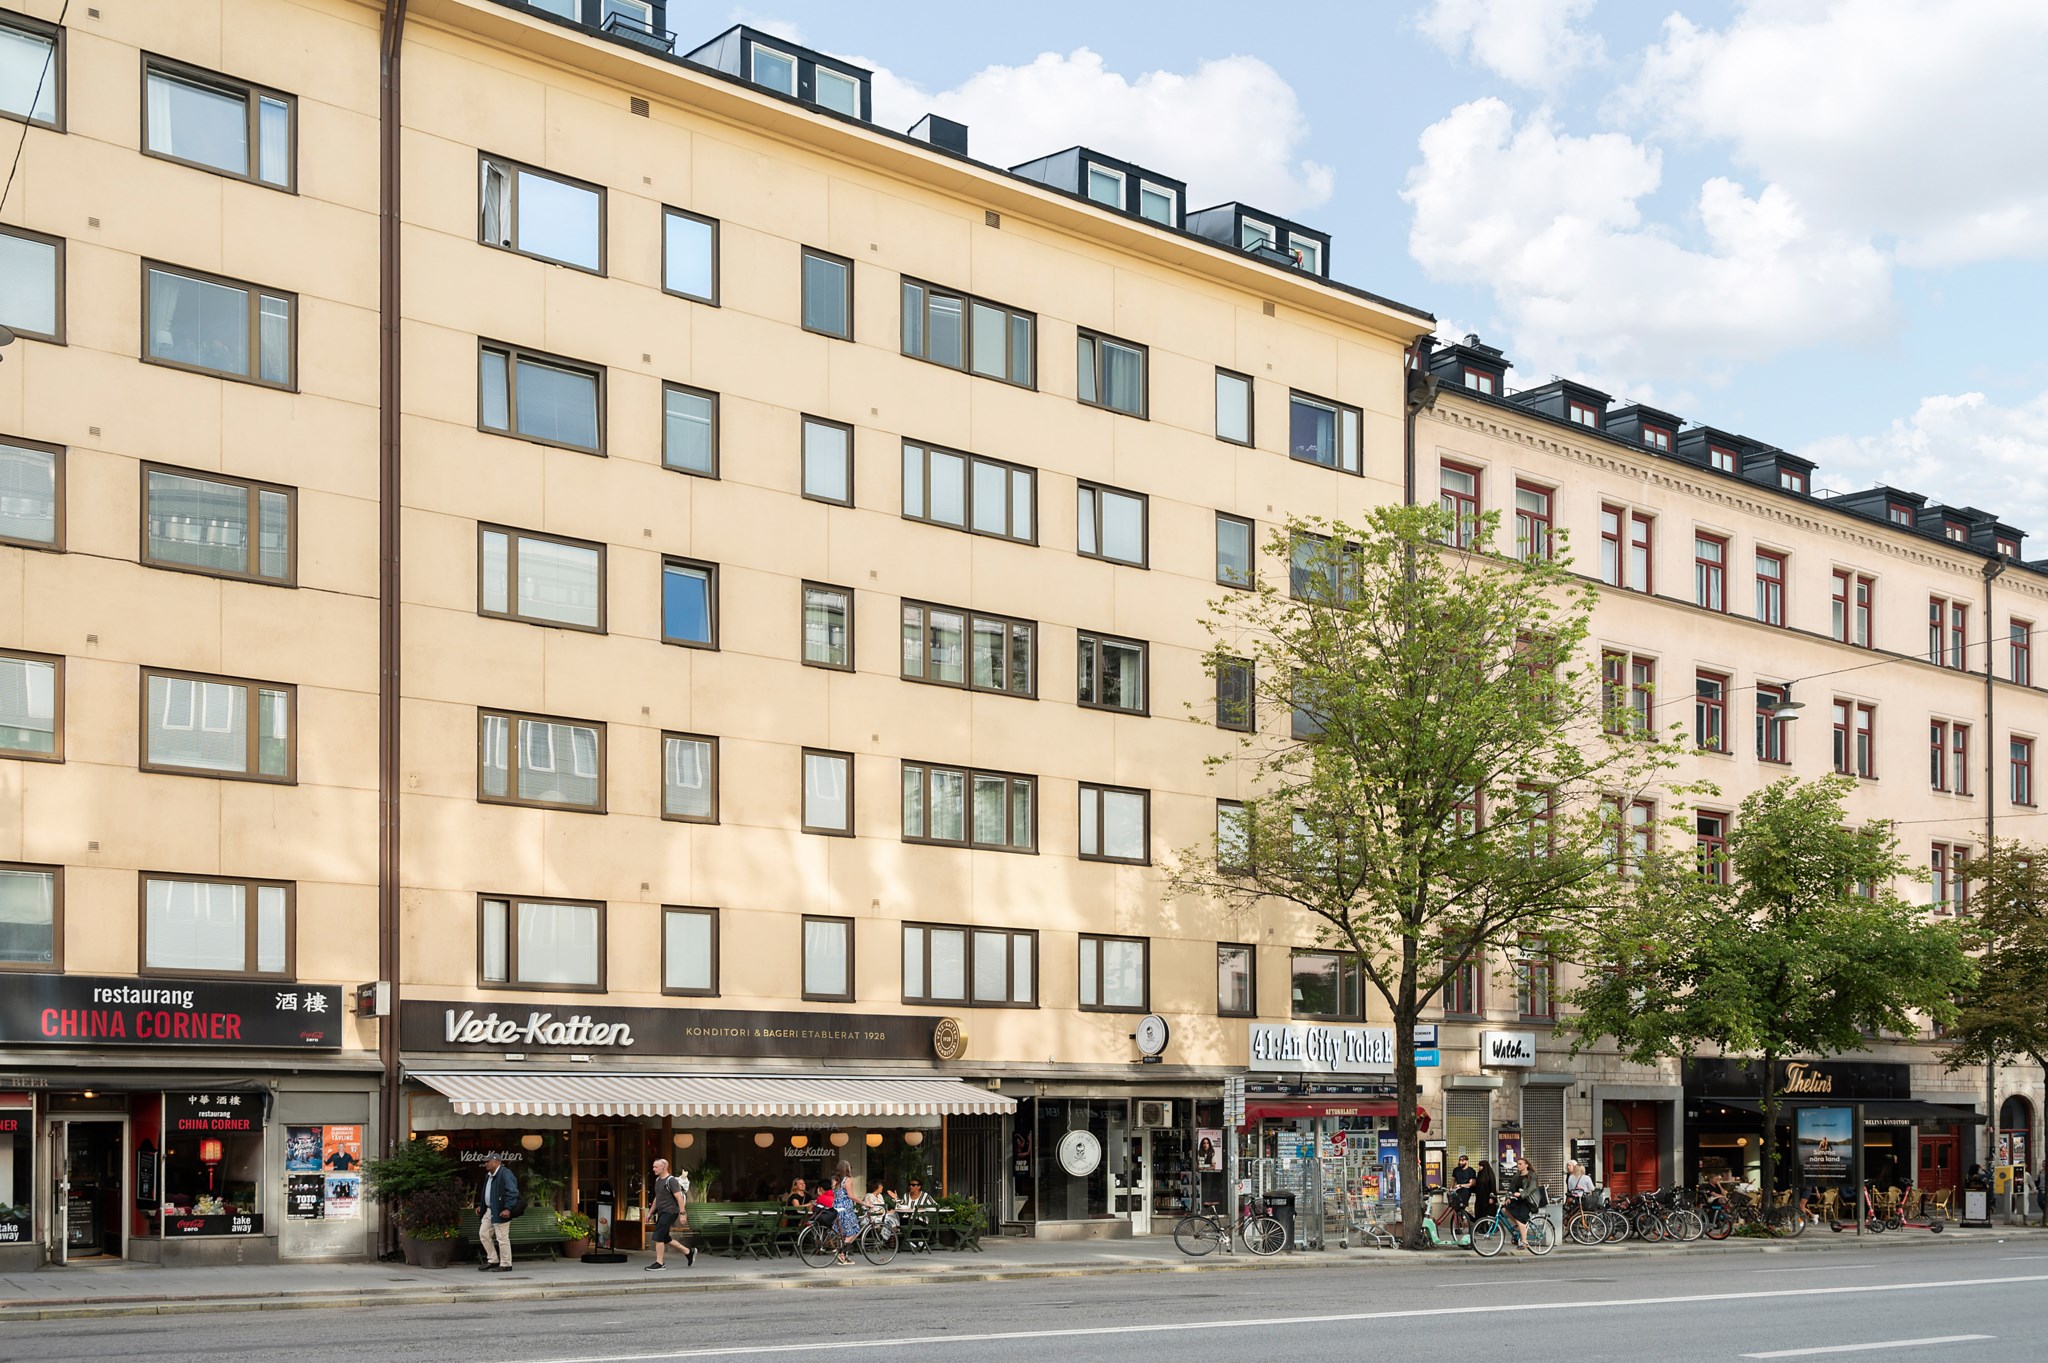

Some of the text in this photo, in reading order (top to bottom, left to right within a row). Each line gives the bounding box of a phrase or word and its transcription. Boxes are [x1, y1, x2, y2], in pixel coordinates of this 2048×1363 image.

[94, 986, 194, 1009] restaurang
[41, 1008, 242, 1040] CHINA CORNER
[445, 1009, 635, 1046] Vete-Katten
[686, 1027, 886, 1040] KONDITORI & BAGERI ETABLERAT 1928
[1254, 1026, 1393, 1070] 41:An City Tobak
[12, 1077, 48, 1087] BEER
[1784, 1062, 1832, 1093] Thelins
[178, 1119, 250, 1130] CHINA CORNER
[1603, 1117, 1613, 1127] 43
[784, 1146, 836, 1157] Vete-Katten
[296, 1194, 316, 1203] TOTO
[177, 1220, 205, 1229] Coca-Cola
[233, 1216, 251, 1225] take
[231, 1224, 252, 1234] away
